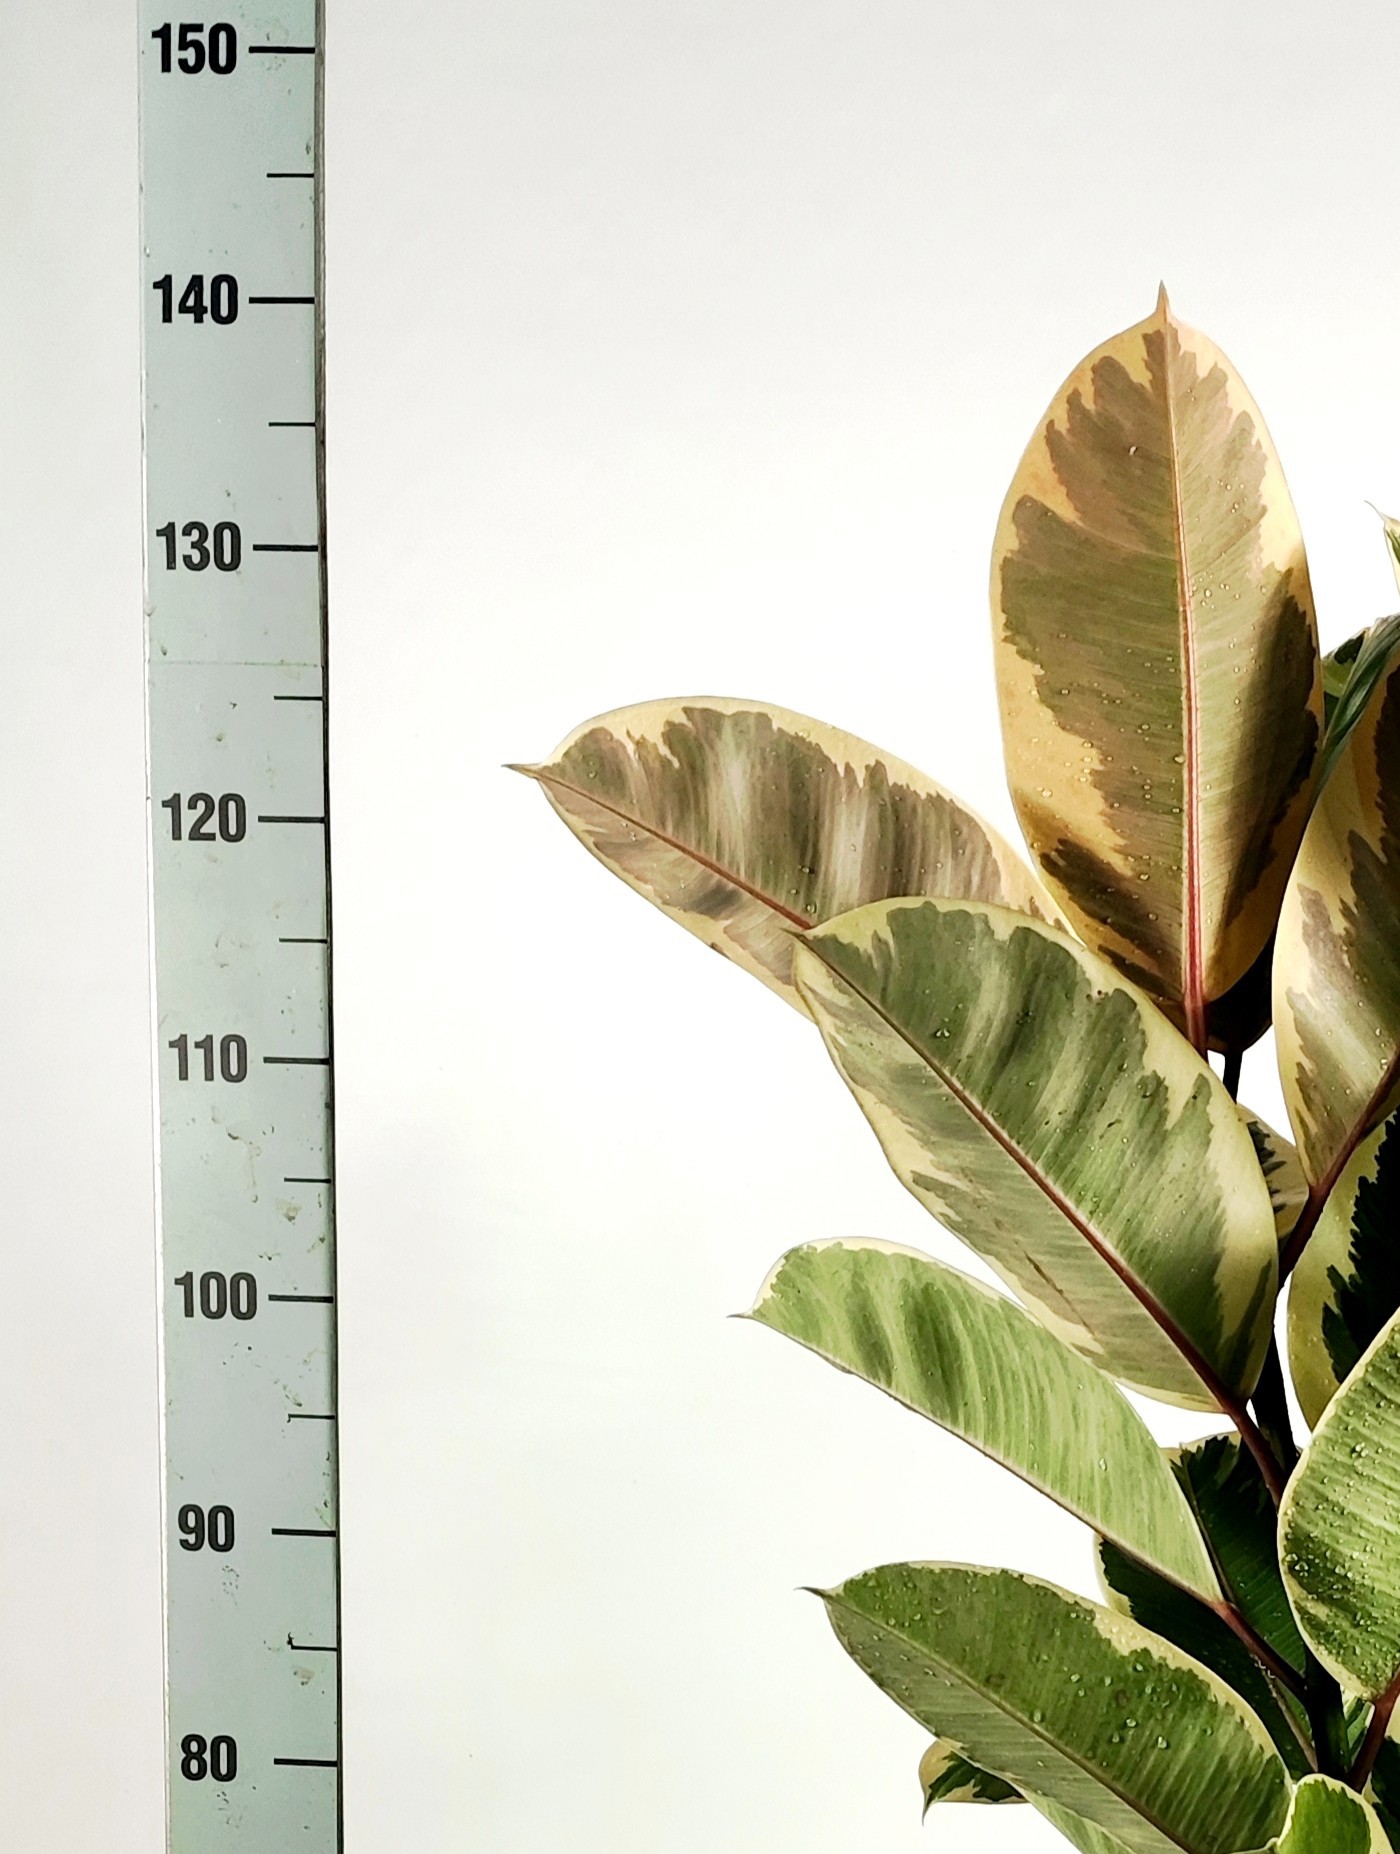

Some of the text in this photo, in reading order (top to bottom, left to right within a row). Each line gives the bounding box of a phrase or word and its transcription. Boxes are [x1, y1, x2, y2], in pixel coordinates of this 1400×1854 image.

[151, 22, 237, 75] 150
[152, 273, 239, 325] 140
[155, 521, 242, 572] 130
[161, 792, 247, 843] 120
[168, 1034, 248, 1083] 110
[174, 1271, 258, 1321] 100
[177, 1503, 235, 1553] 90
[180, 1733, 238, 1783] 80
